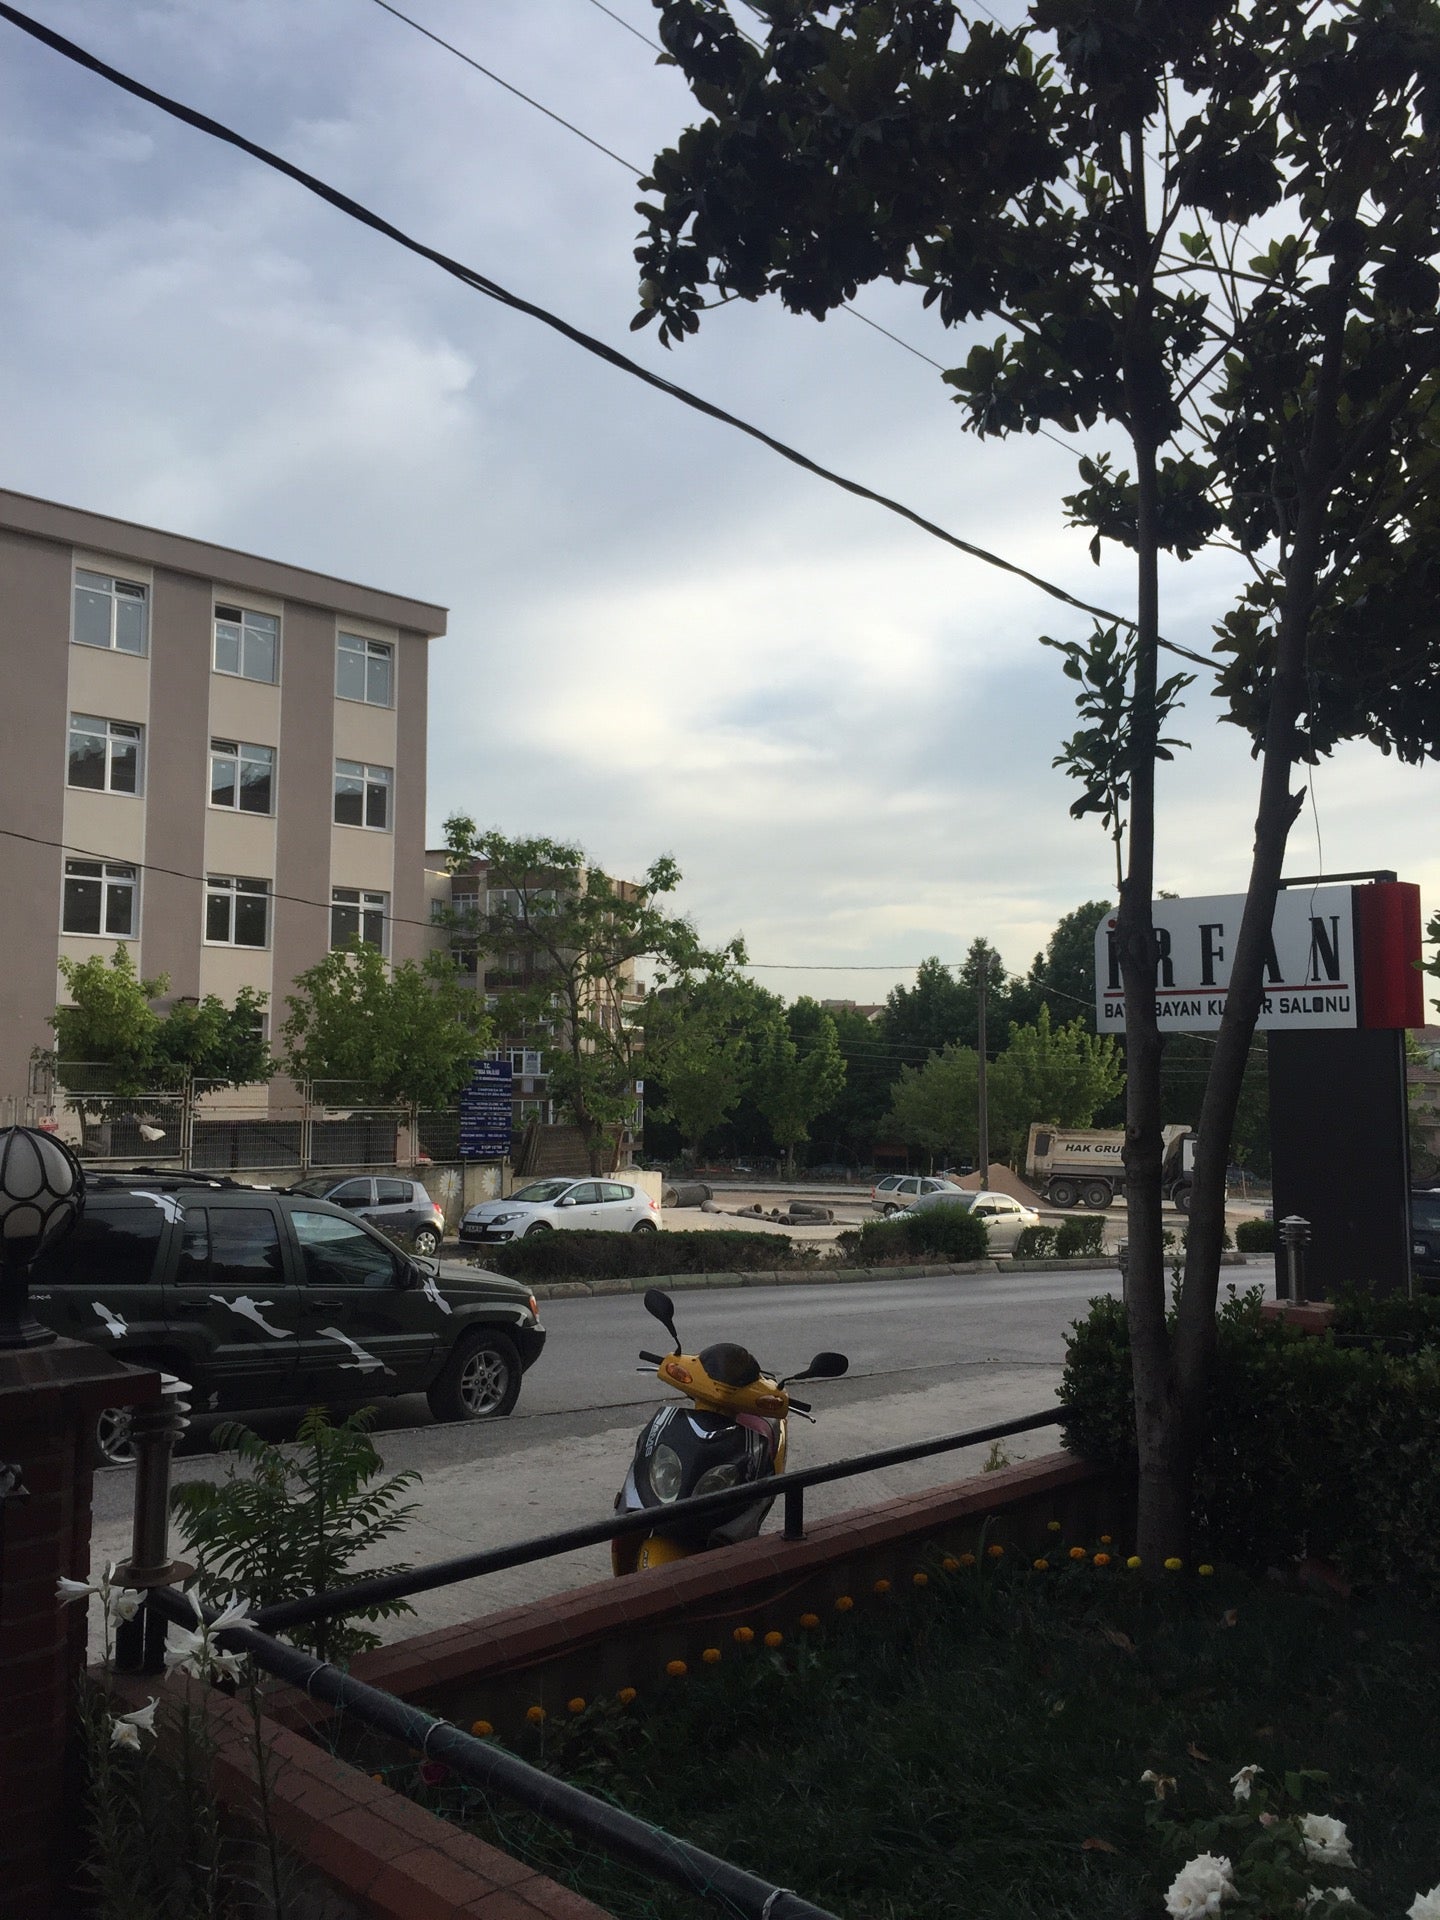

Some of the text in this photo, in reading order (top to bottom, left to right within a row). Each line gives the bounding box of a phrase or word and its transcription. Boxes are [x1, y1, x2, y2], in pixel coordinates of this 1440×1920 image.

[1104, 995, 1350, 1018] BA BAYAN KUR SALONU
[1065, 1144, 1091, 1152] HAK
